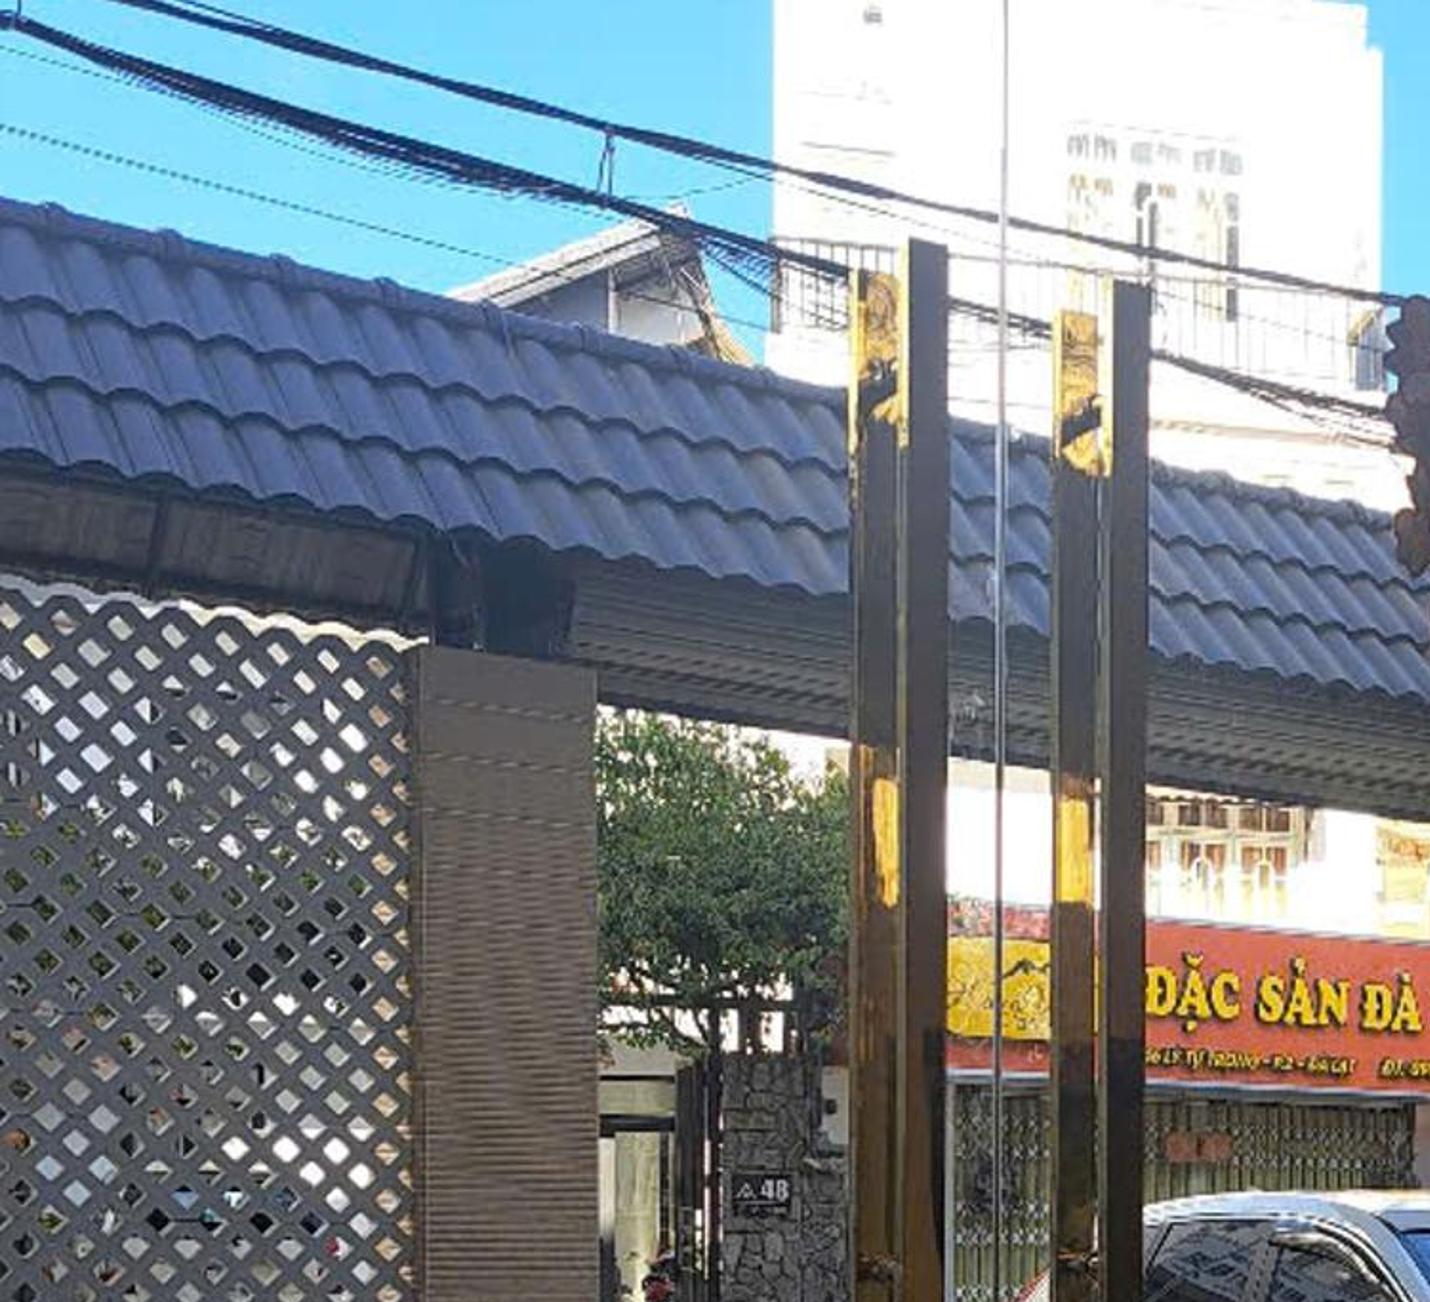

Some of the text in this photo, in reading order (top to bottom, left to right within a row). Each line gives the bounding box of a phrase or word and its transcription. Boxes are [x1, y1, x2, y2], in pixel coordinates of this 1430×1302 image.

[1146, 951, 1241, 1033] ĐẶC
[1257, 956, 1351, 1027] SẢN
[1362, 971, 1422, 1033] ĐÀ
